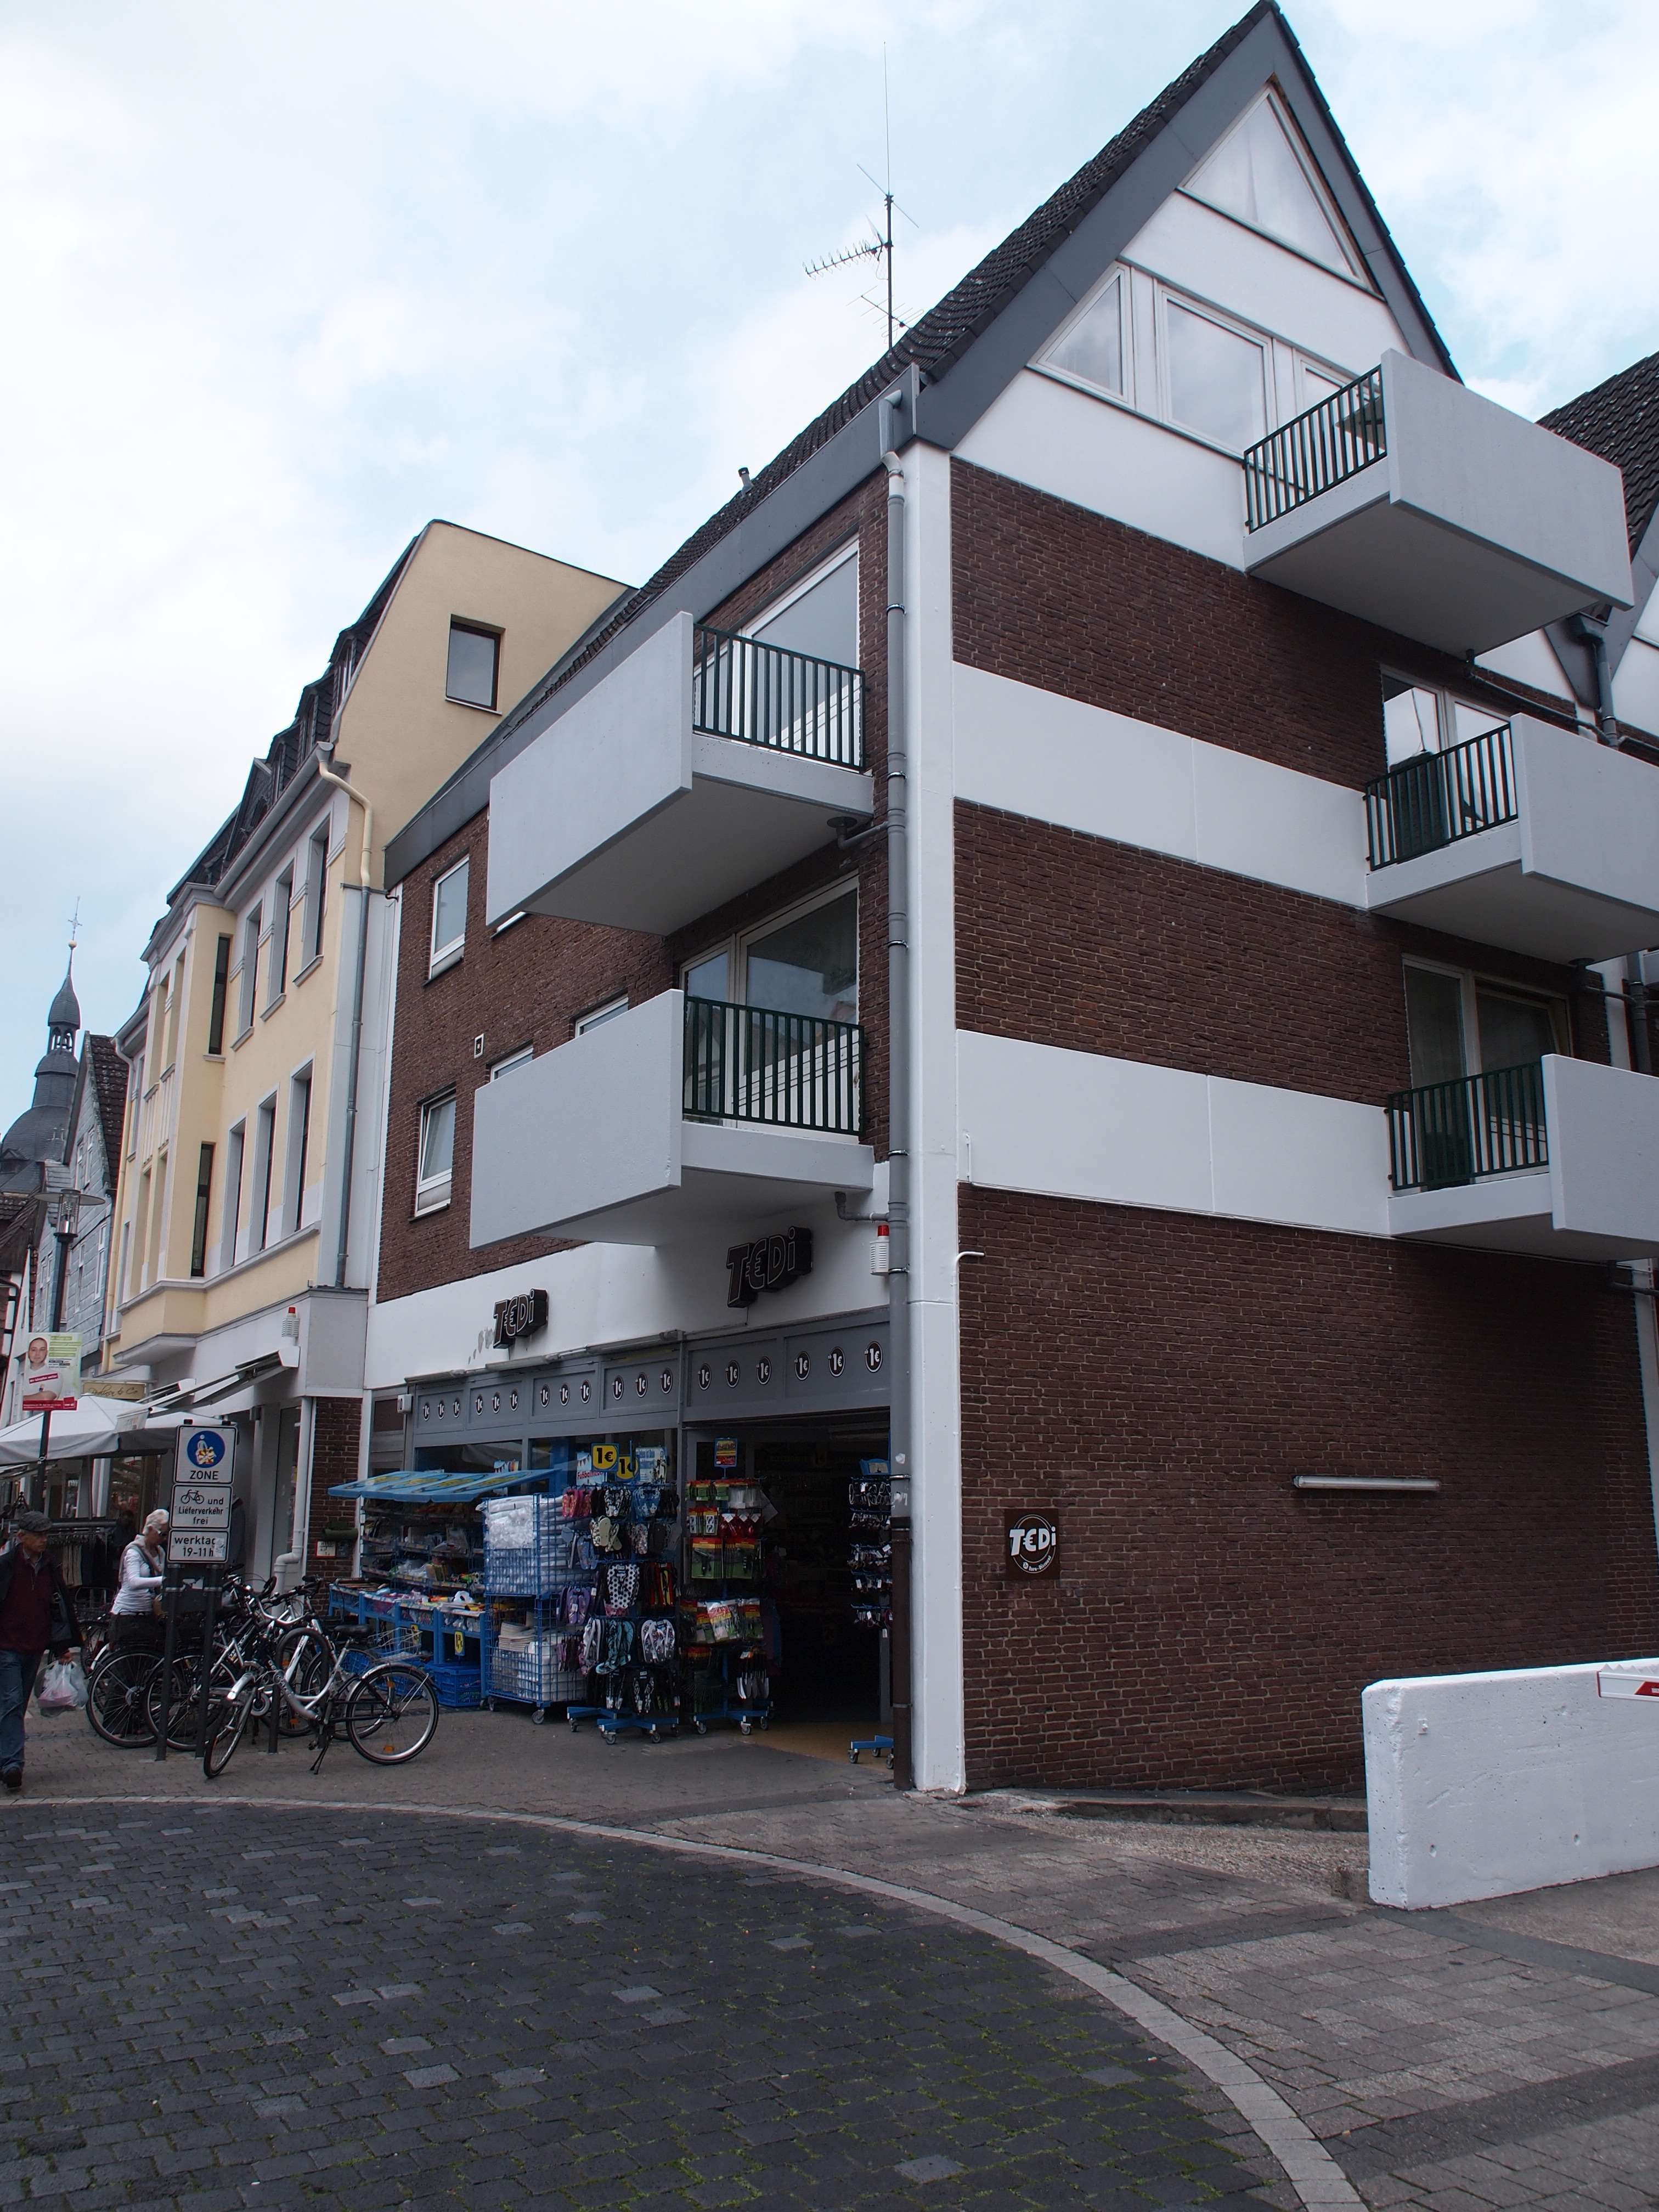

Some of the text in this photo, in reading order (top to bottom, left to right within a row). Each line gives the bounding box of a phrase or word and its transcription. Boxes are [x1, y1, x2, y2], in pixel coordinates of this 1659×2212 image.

[833, 1353, 842, 1370] 1€
[870, 1348, 880, 1366] 1€
[799, 1357, 808, 1374] 1€
[597, 1447, 613, 1464] 1€
[190, 1470, 219, 1480] ZONE
[178, 1506, 223, 1515] Lieferverkehr
[193, 1516, 208, 1525] frei
[209, 1547, 213, 1557] h
